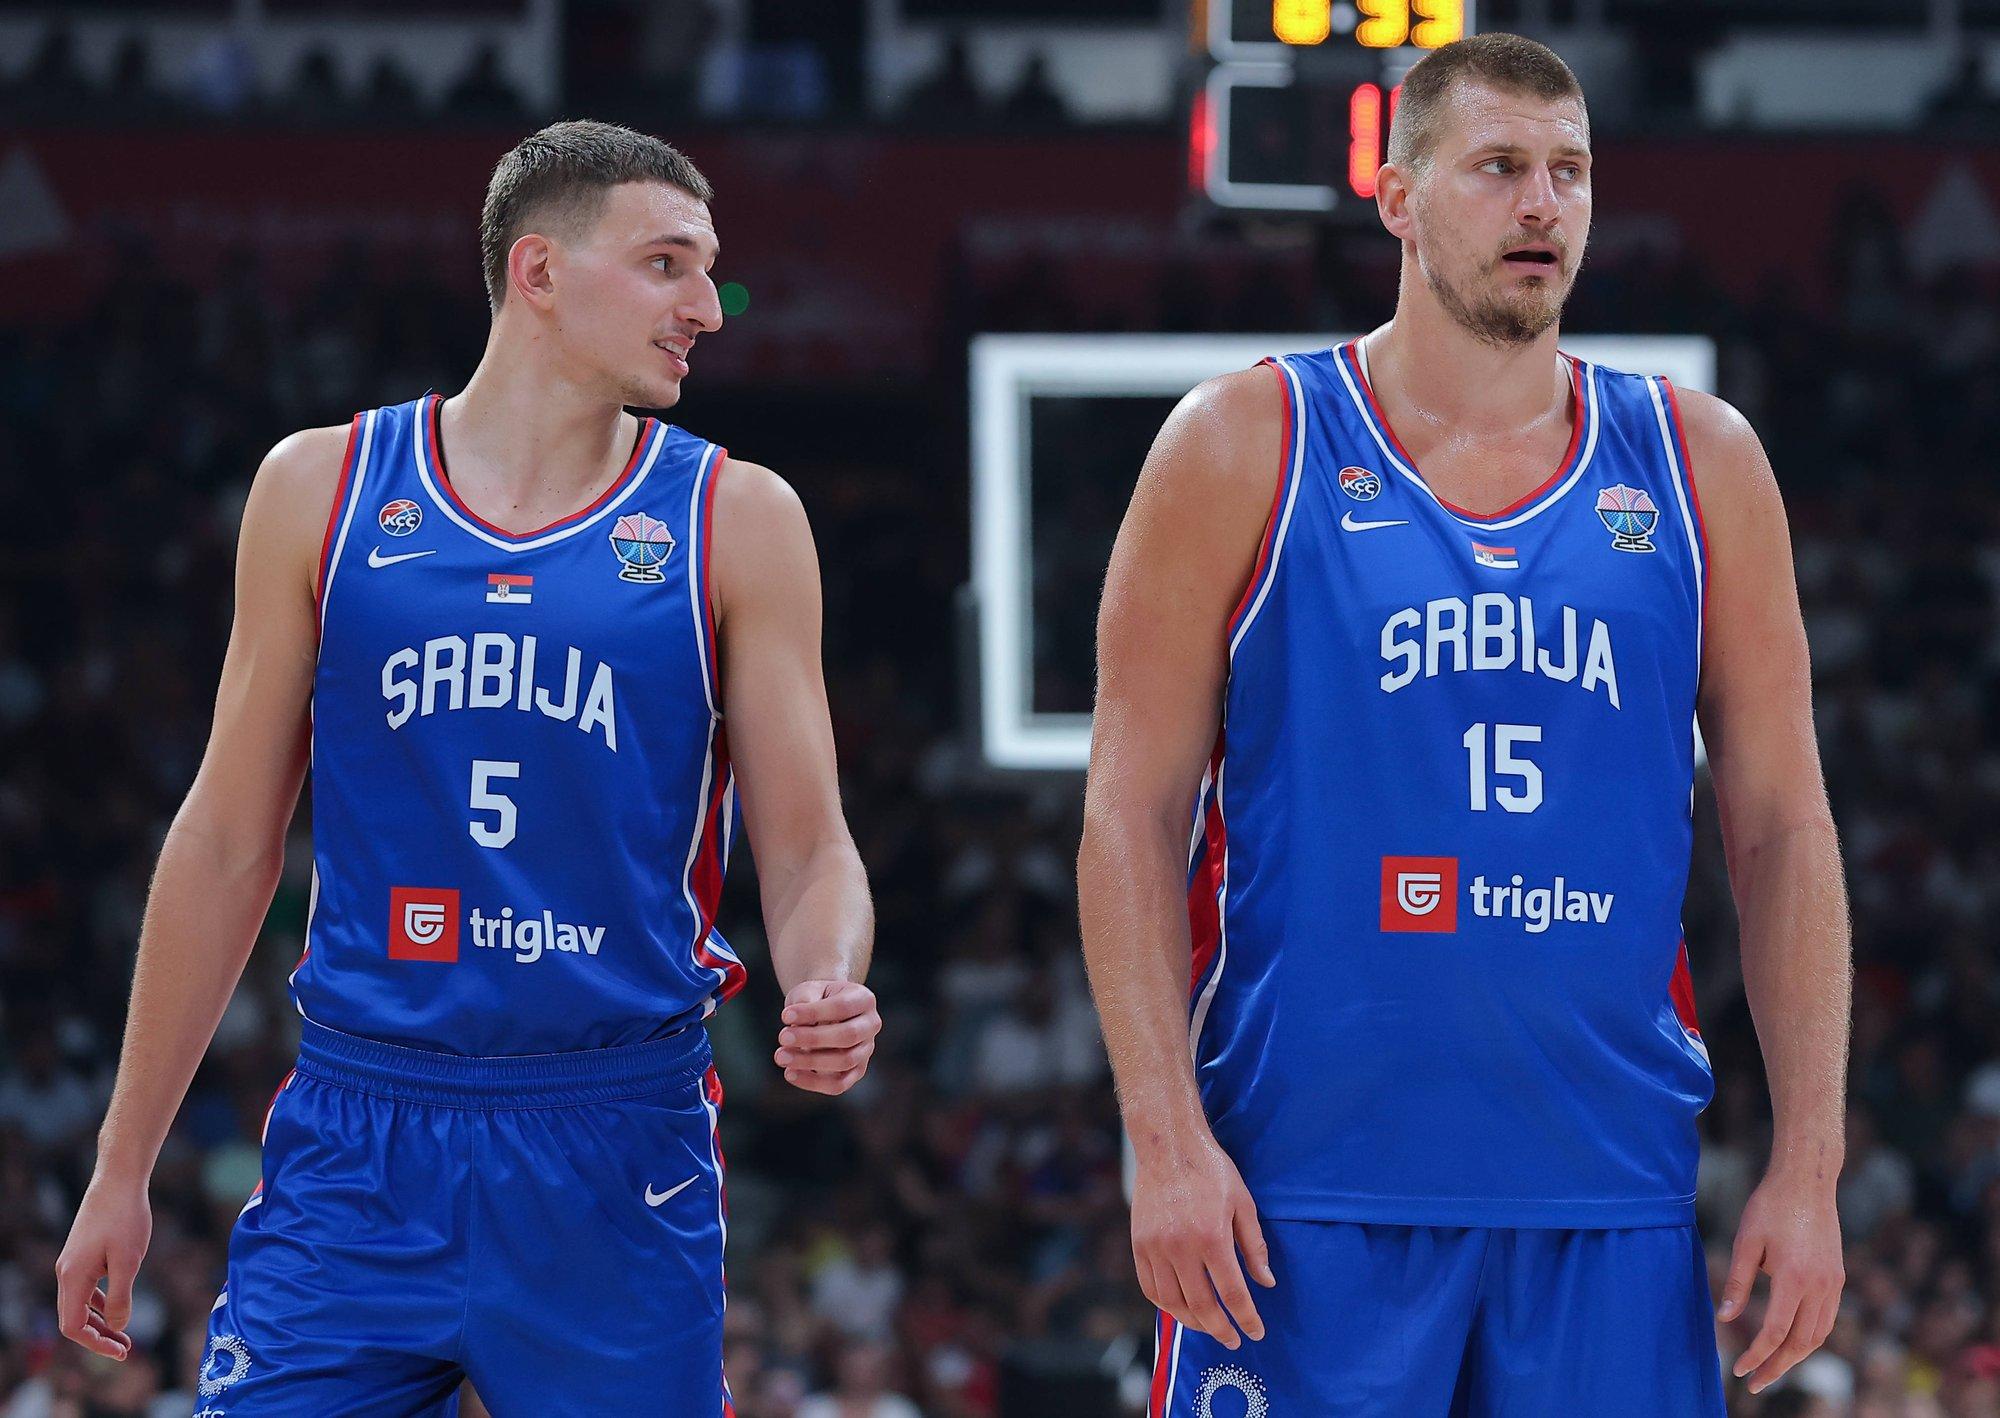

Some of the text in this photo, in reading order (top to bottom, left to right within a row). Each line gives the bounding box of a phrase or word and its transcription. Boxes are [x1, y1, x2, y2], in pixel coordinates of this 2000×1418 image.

[381, 632, 617, 753] SRBIJA
[1380, 592, 1621, 711] SRBIJA
[469, 759, 520, 849] 5
[1463, 722, 1543, 813] 15
[469, 907, 606, 963] triglav
[1470, 874, 1614, 933] triglav
